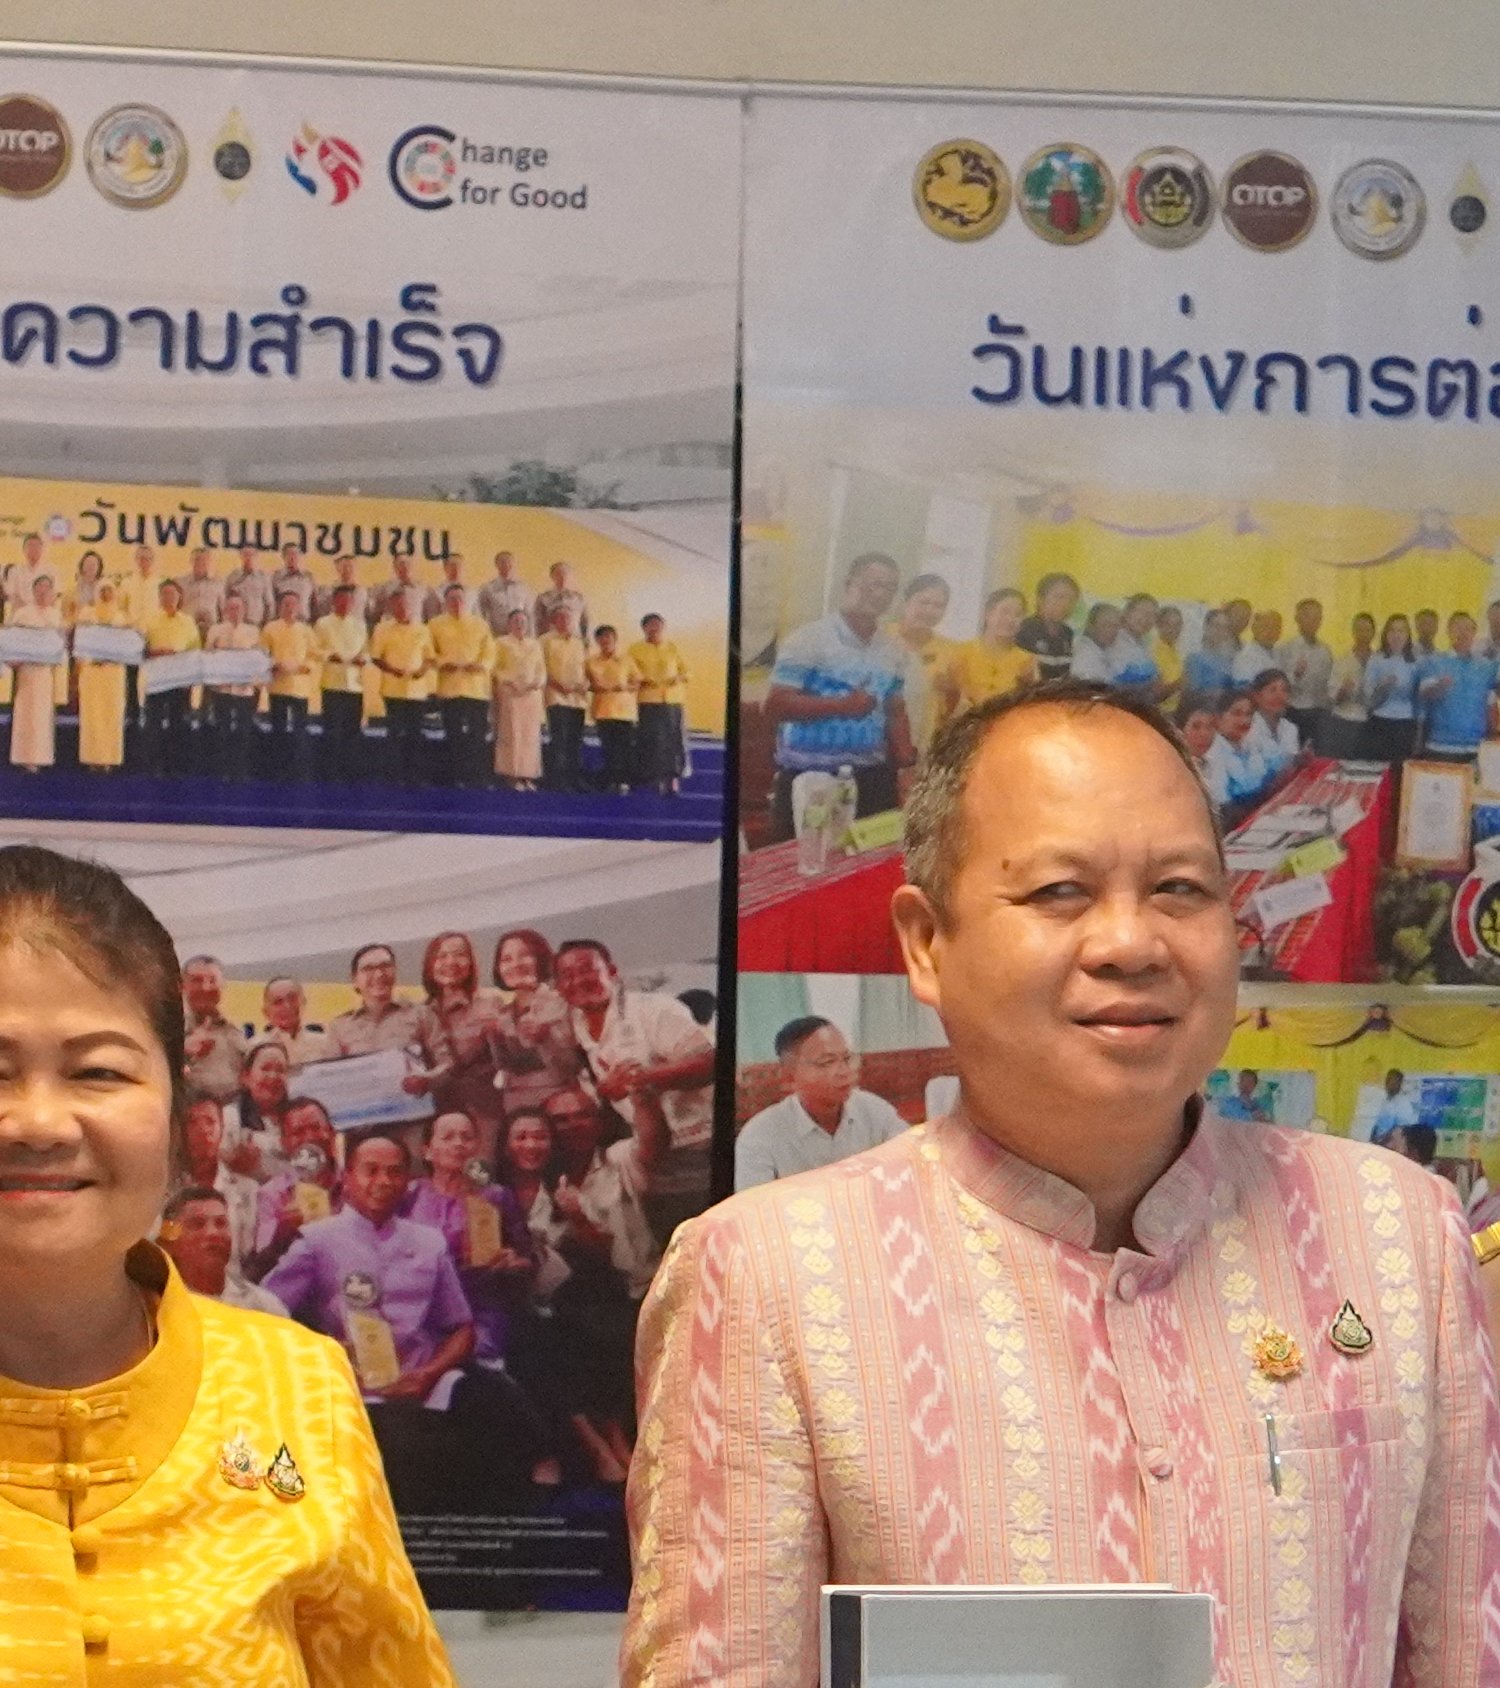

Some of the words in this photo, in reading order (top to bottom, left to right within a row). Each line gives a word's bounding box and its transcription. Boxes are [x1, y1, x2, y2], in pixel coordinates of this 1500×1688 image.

[460, 178, 501, 205] for
[509, 182, 588, 210] Good
[1232, 184, 1303, 206] OTOP
